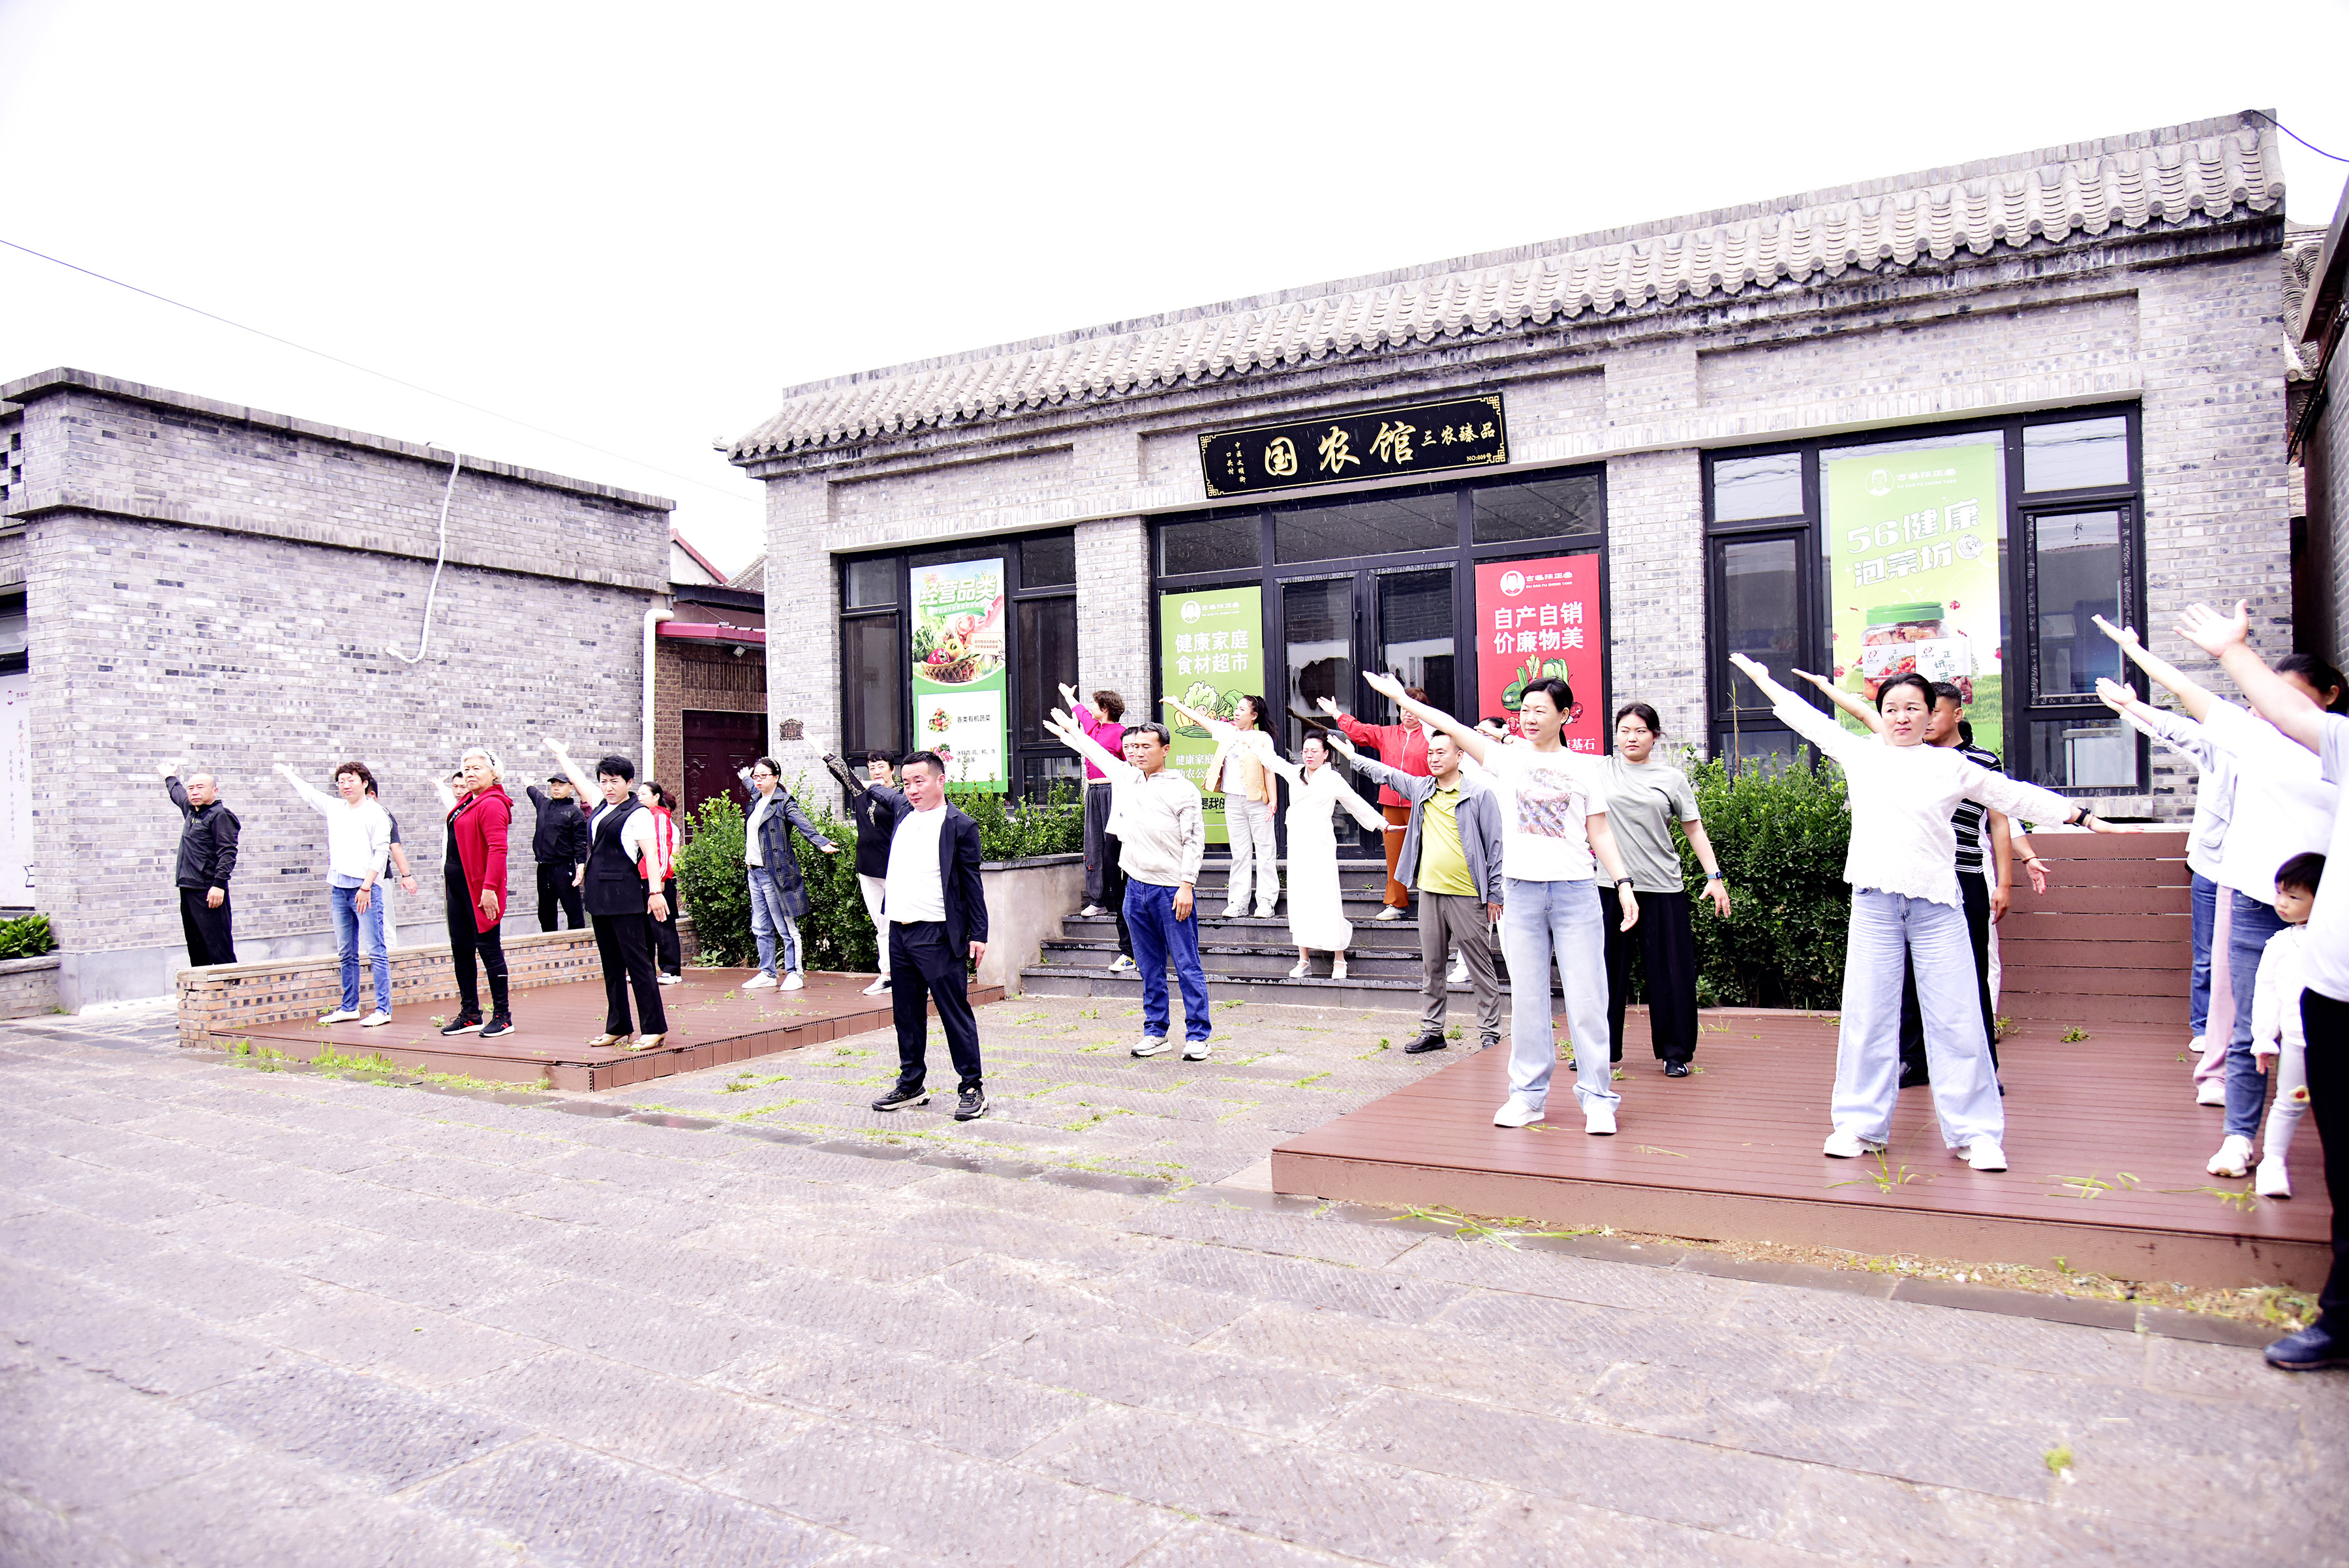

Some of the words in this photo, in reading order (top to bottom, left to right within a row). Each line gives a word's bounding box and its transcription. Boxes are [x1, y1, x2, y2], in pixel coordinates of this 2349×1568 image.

[1421, 421, 1496, 446] 三农臻品
[1265, 421, 1417, 476] 国农馆
[1847, 497, 1980, 555] 56健康
[1854, 541, 1953, 589] 泡菜坊
[919, 574, 997, 607] 经营品类
[1494, 601, 1583, 630] 自产自销
[1175, 628, 1249, 654] 健康家庭
[1493, 626, 1584, 654] 价廉物美
[1175, 652, 1250, 675] 食材超市
[957, 714, 990, 723] 各类有机蔬菜
